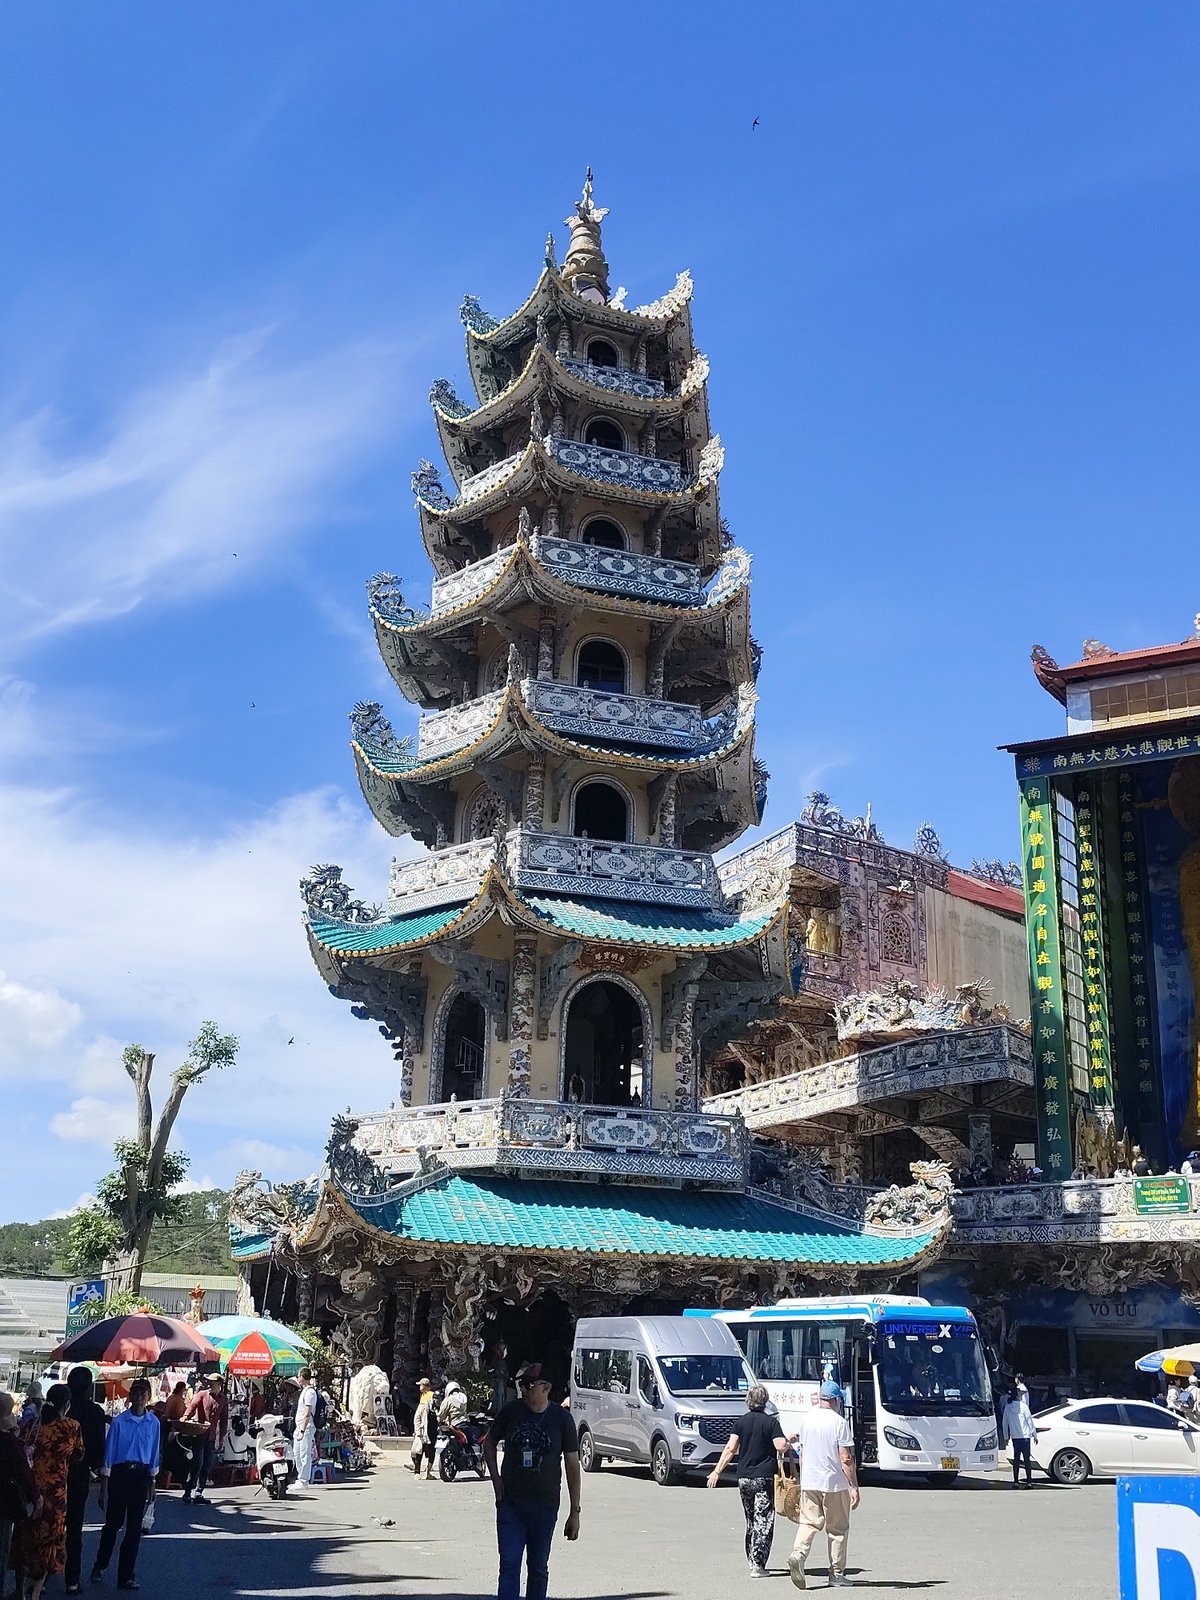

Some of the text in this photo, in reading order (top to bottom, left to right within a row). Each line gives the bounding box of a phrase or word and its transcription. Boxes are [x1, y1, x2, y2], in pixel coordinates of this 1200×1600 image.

[71, 1284, 87, 1302] P
[1089, 1301, 1109, 1317] VÔ
[884, 1324, 938, 1334] UNIVERSE
[938, 1324, 952, 1339] X
[952, 1325, 975, 1333] VIP
